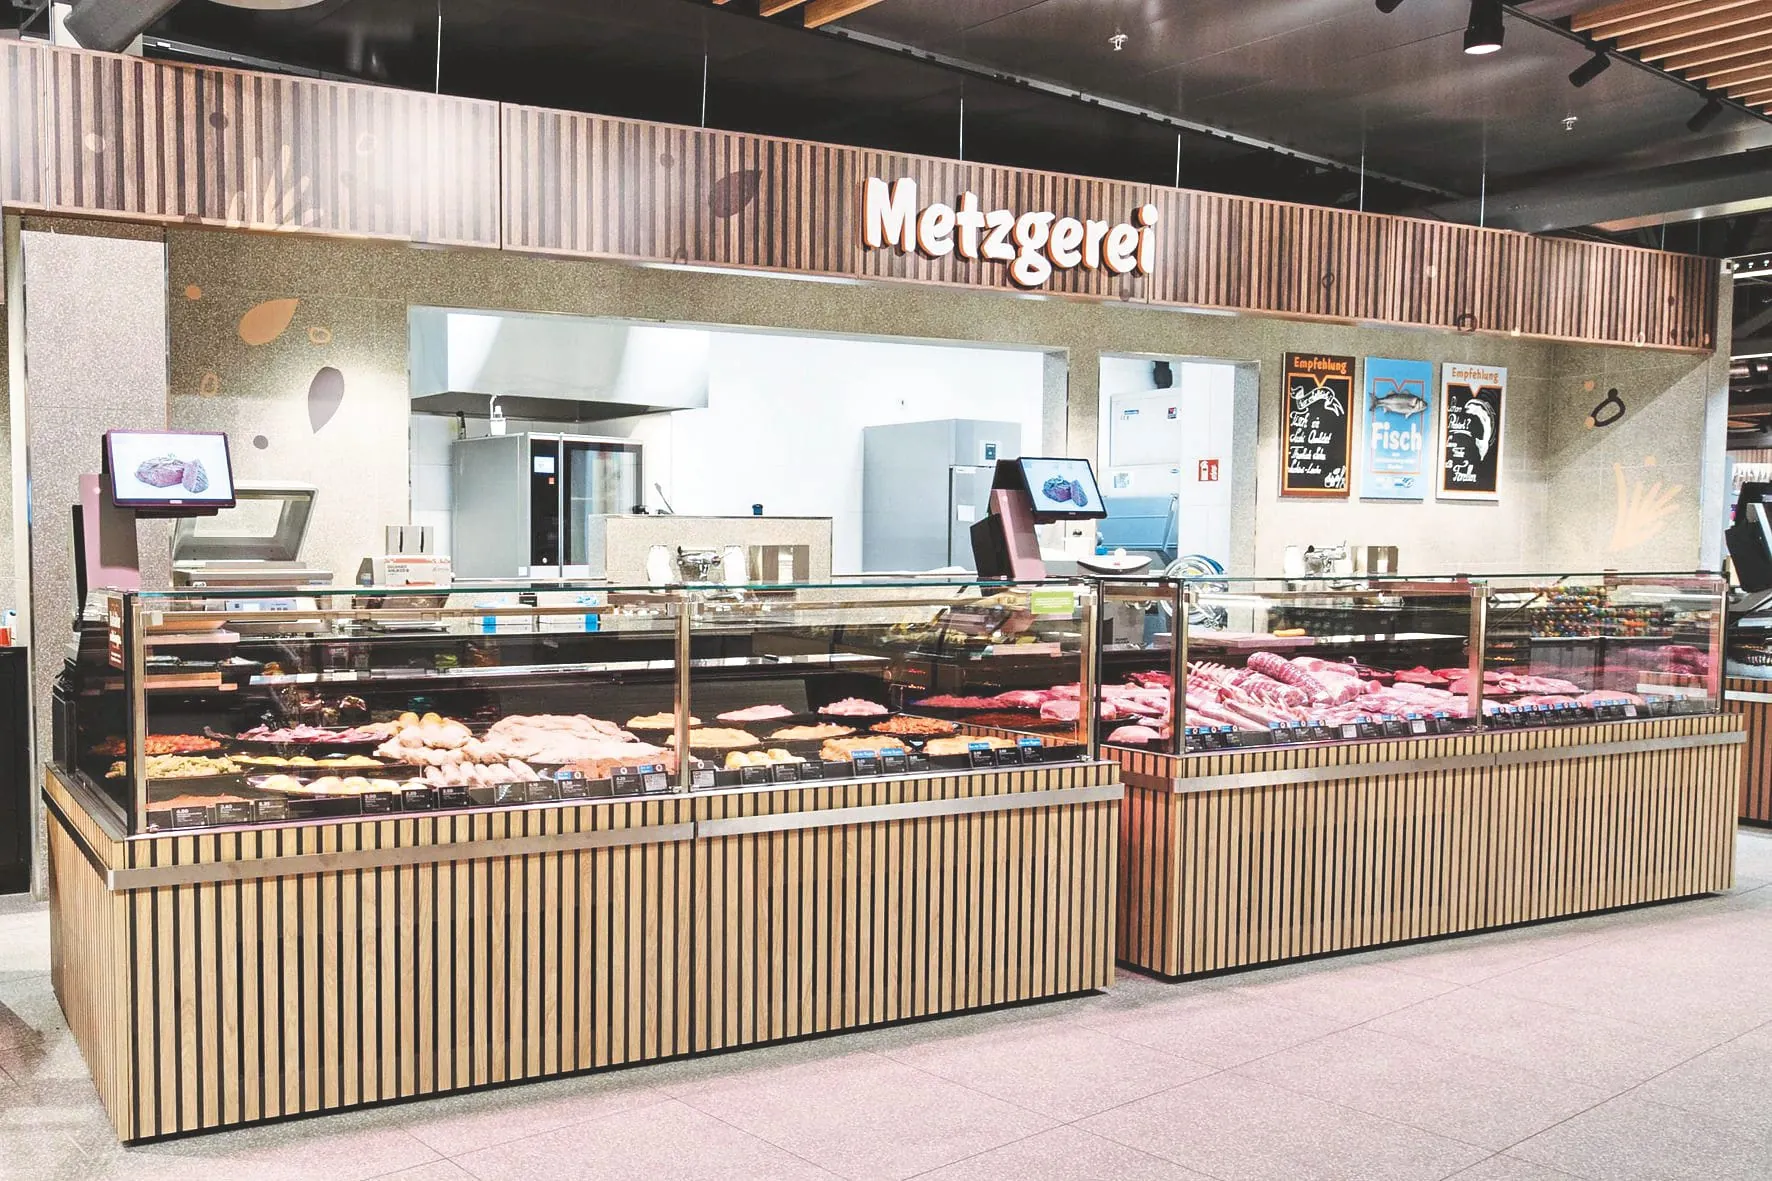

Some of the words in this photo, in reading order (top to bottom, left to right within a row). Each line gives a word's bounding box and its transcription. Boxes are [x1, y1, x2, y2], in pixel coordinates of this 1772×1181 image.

[863, 177, 1158, 286] Metzgerei
[1293, 357, 1347, 374] Empfehlung
[1452, 367, 1499, 384] Empfehlung
[1371, 422, 1422, 452] Fisch
